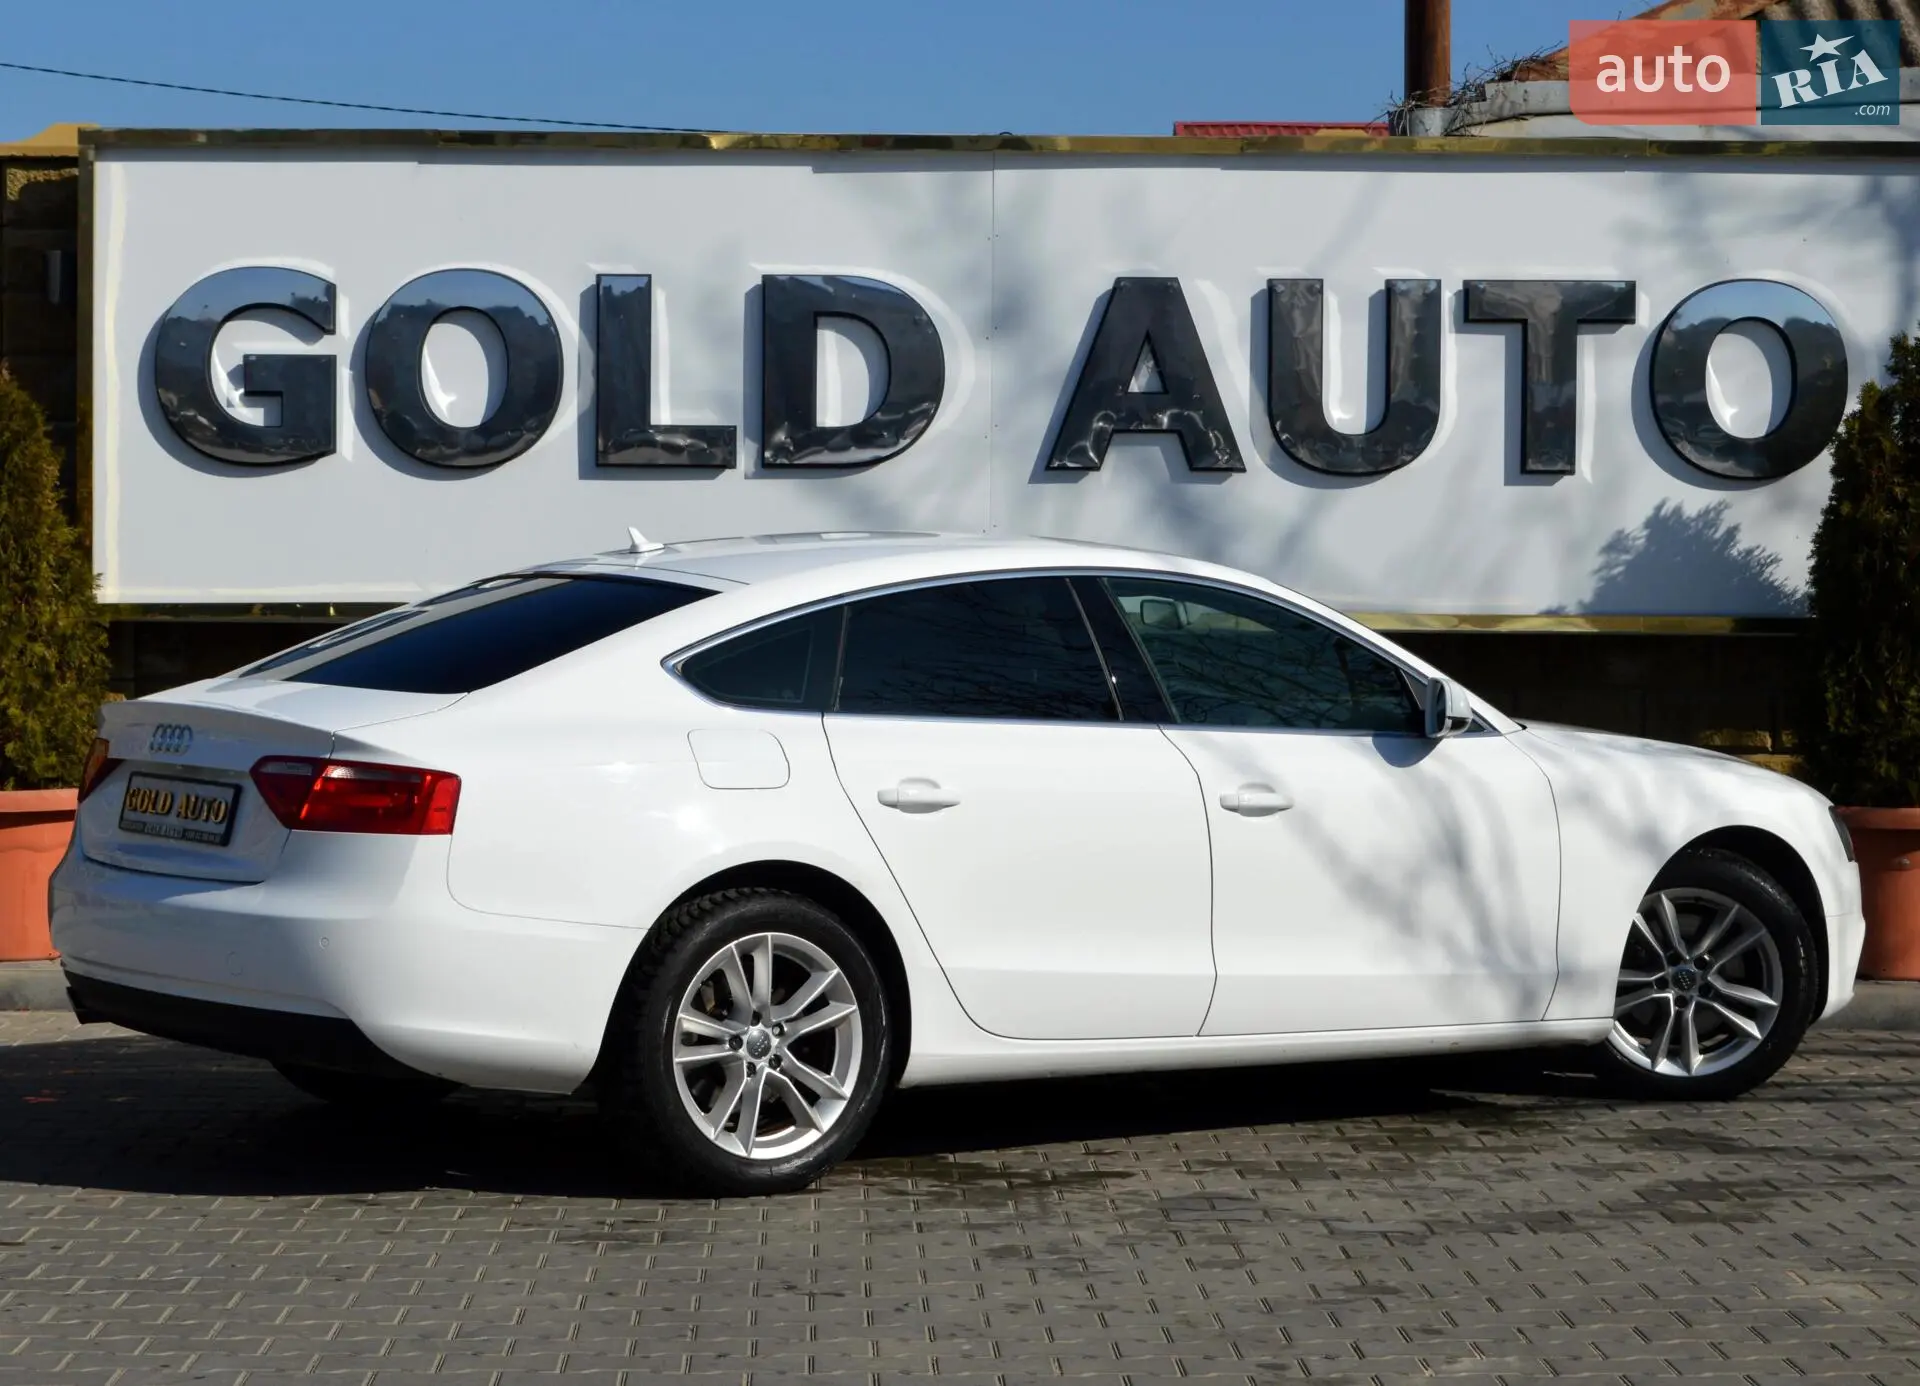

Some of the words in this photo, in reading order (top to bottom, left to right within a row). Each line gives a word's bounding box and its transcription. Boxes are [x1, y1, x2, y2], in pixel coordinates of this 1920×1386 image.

[153, 265, 946, 470] GOLD
[1044, 275, 1850, 481] AUTO
[126, 787, 173, 815] GOLD
[176, 793, 229, 825] AUTO
